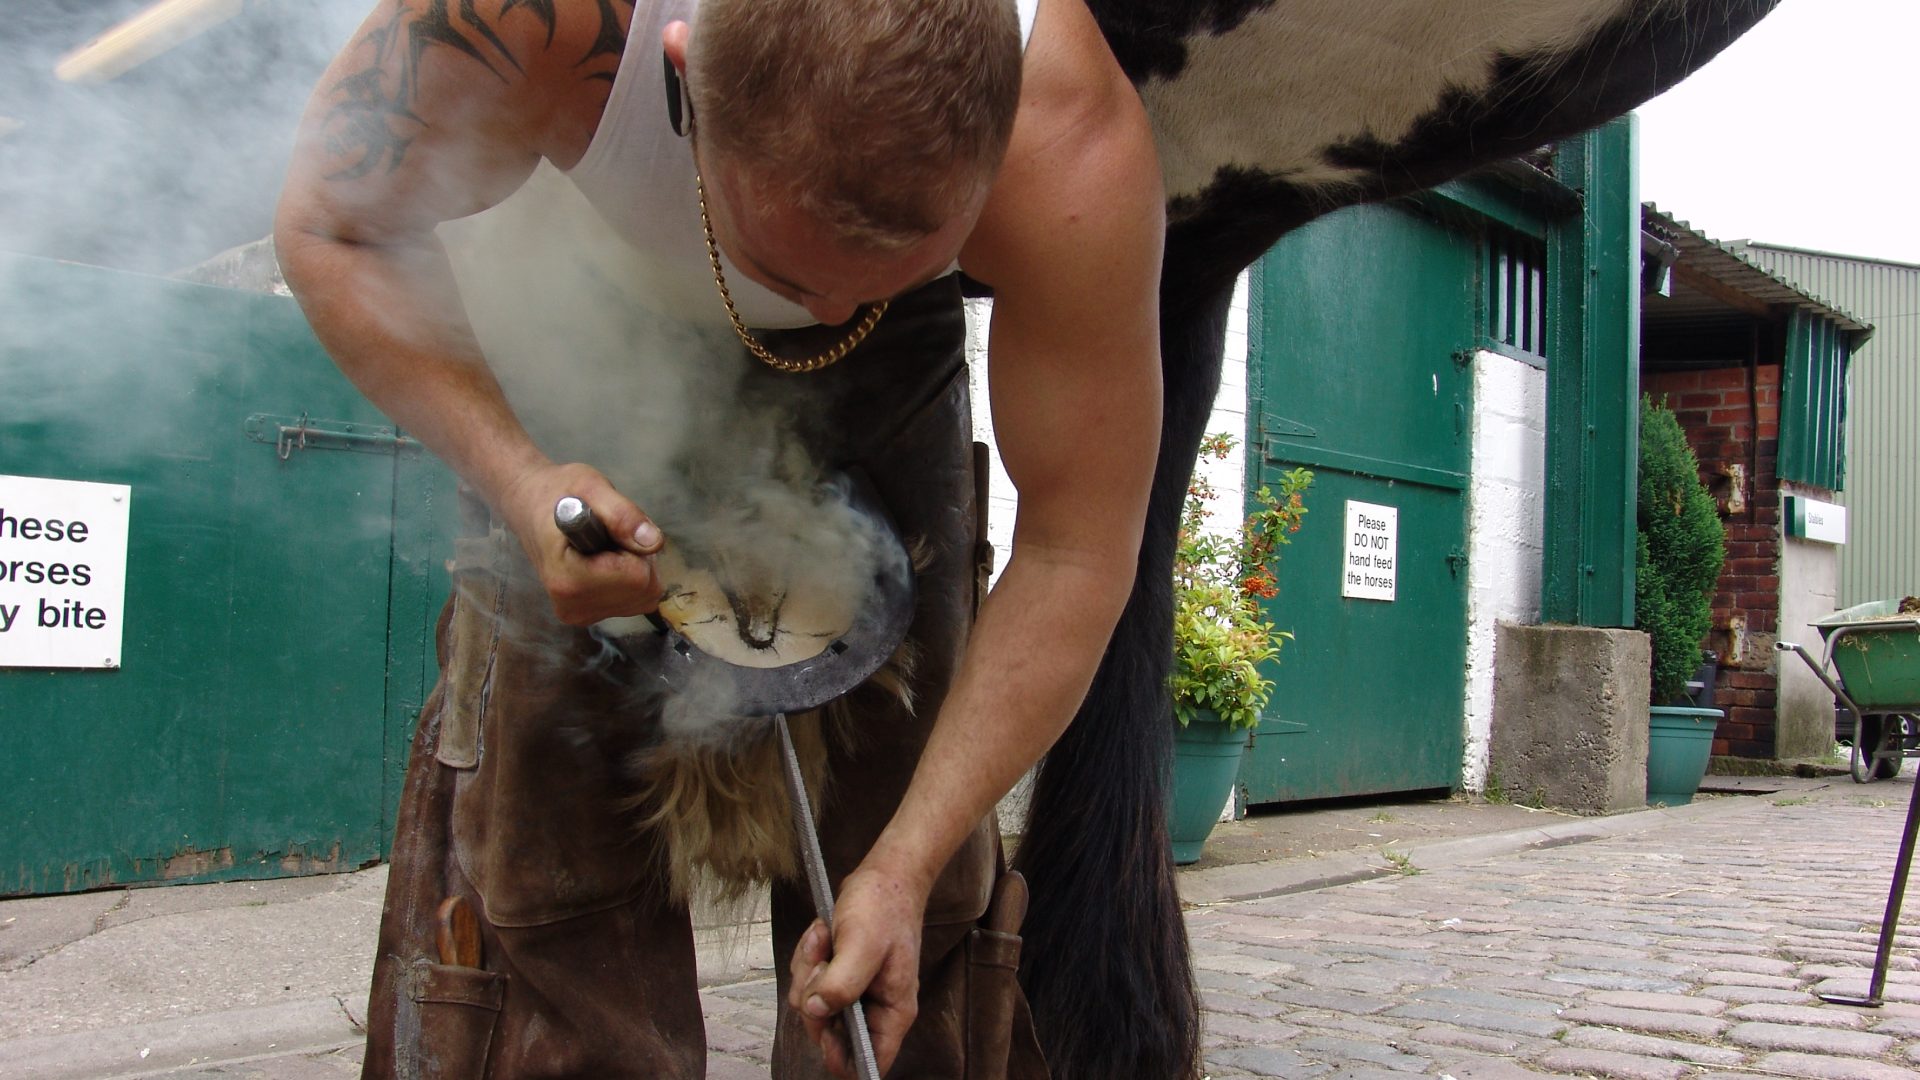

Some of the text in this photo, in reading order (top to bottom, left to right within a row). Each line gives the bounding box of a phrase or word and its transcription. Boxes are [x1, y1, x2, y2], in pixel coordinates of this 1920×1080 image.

[1358, 514, 1386, 531] Please
[1354, 533, 1389, 550] DO NOT
[1349, 552, 1392, 570] hand feed
[1347, 571, 1393, 589] the horses
[38, 598, 107, 630] bite
